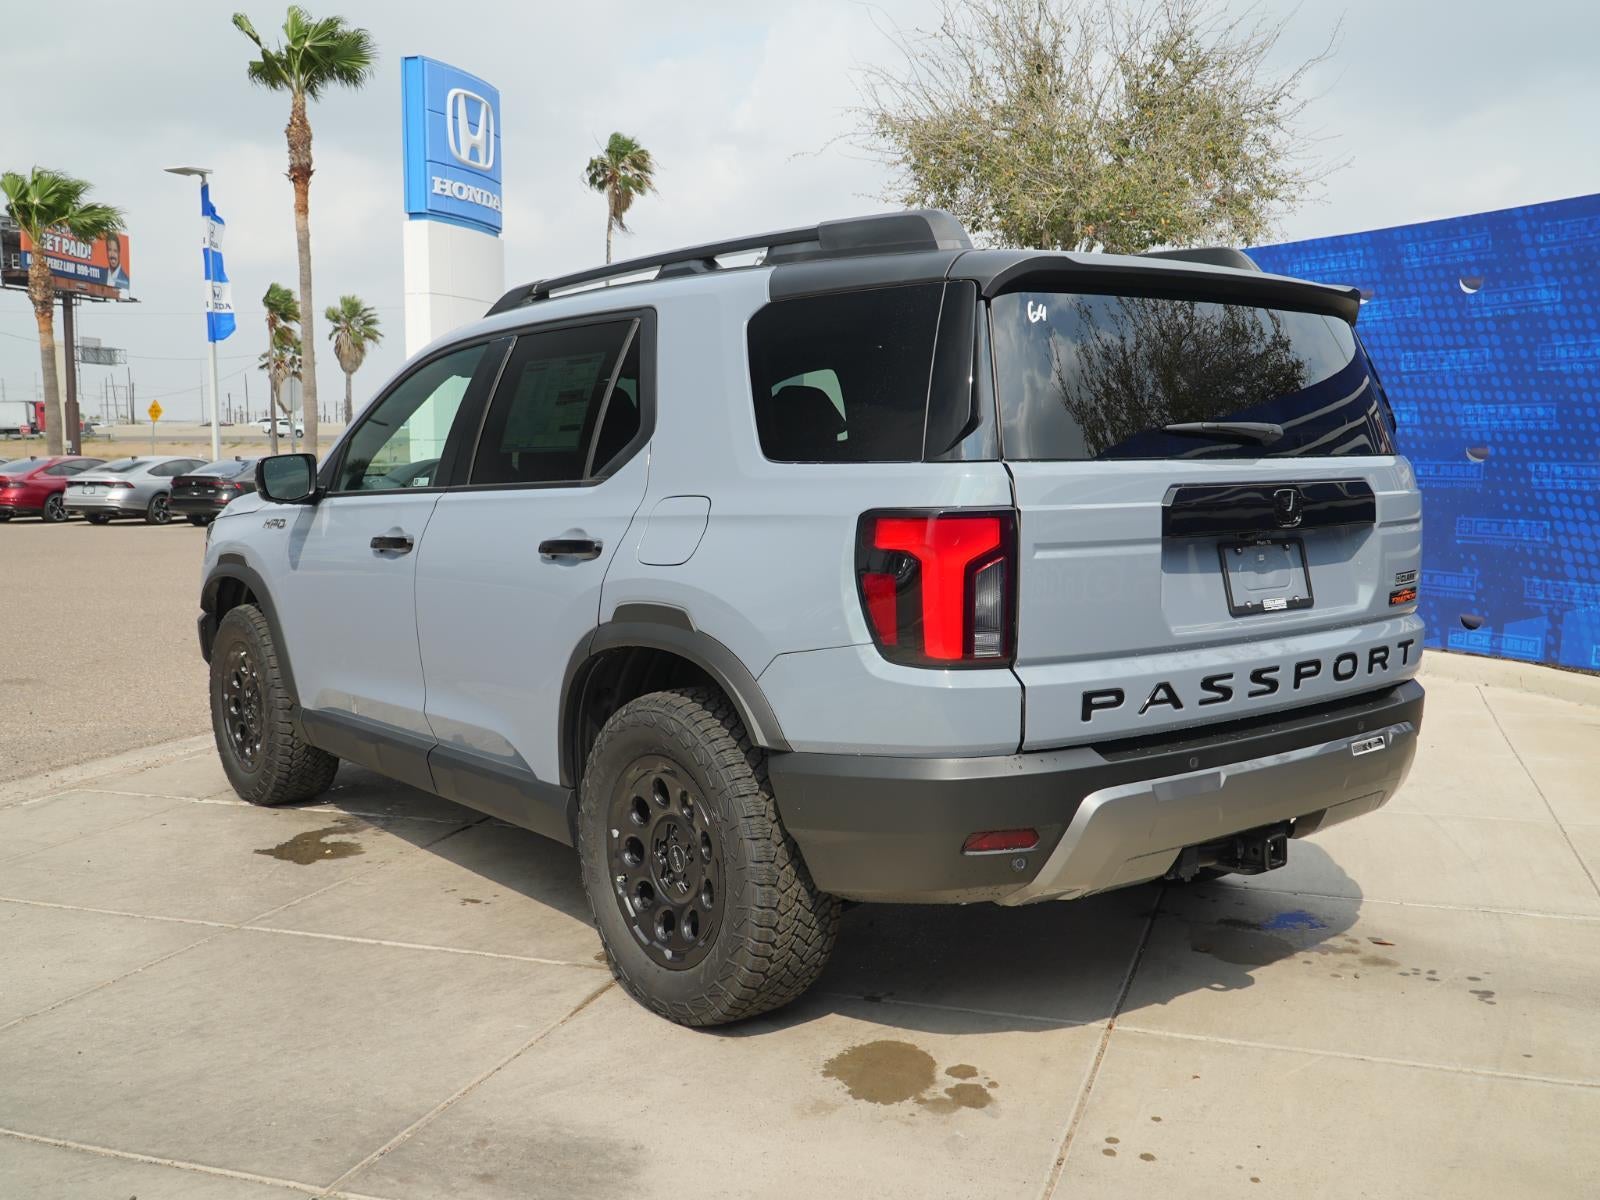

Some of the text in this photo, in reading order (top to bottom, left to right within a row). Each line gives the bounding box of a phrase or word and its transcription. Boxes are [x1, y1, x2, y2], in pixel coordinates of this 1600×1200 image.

[432, 176, 501, 210] HONDA
[62, 238, 92, 260] PAID!
[64, 262, 76, 274] LAW
[1081, 639, 1414, 722] PASSPORT
